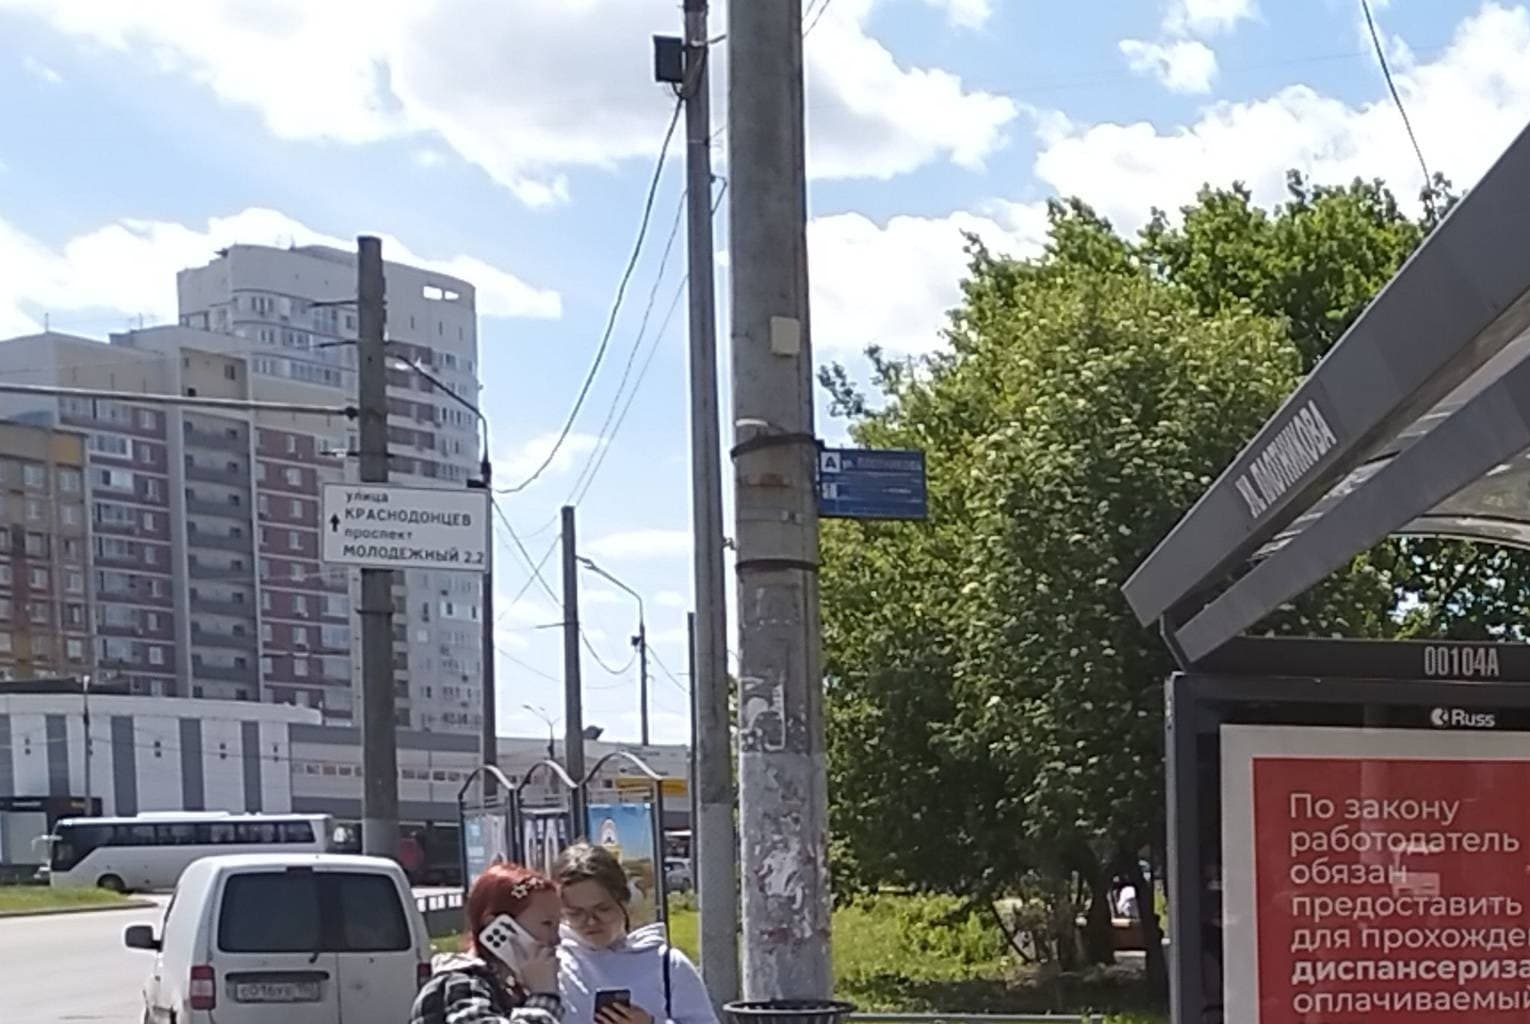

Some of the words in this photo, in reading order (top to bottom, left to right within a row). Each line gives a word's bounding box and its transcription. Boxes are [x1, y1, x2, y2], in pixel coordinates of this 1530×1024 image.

[345, 492, 389, 504] улица
[344, 508, 472, 526] КРАСНОДОНЦЕВ
[344, 528, 413, 541] проспект
[343, 543, 459, 562] МОЛОДЕЖНЫЙ
[1450, 708, 1496, 728] Russ
[1289, 793, 1336, 820] По
[1344, 797, 1460, 824] закону
[1290, 825, 1520, 857] работодатель
[1290, 858, 1407, 885] обязан
[1291, 893, 1522, 922] предоставить
[1291, 927, 1352, 952] для
